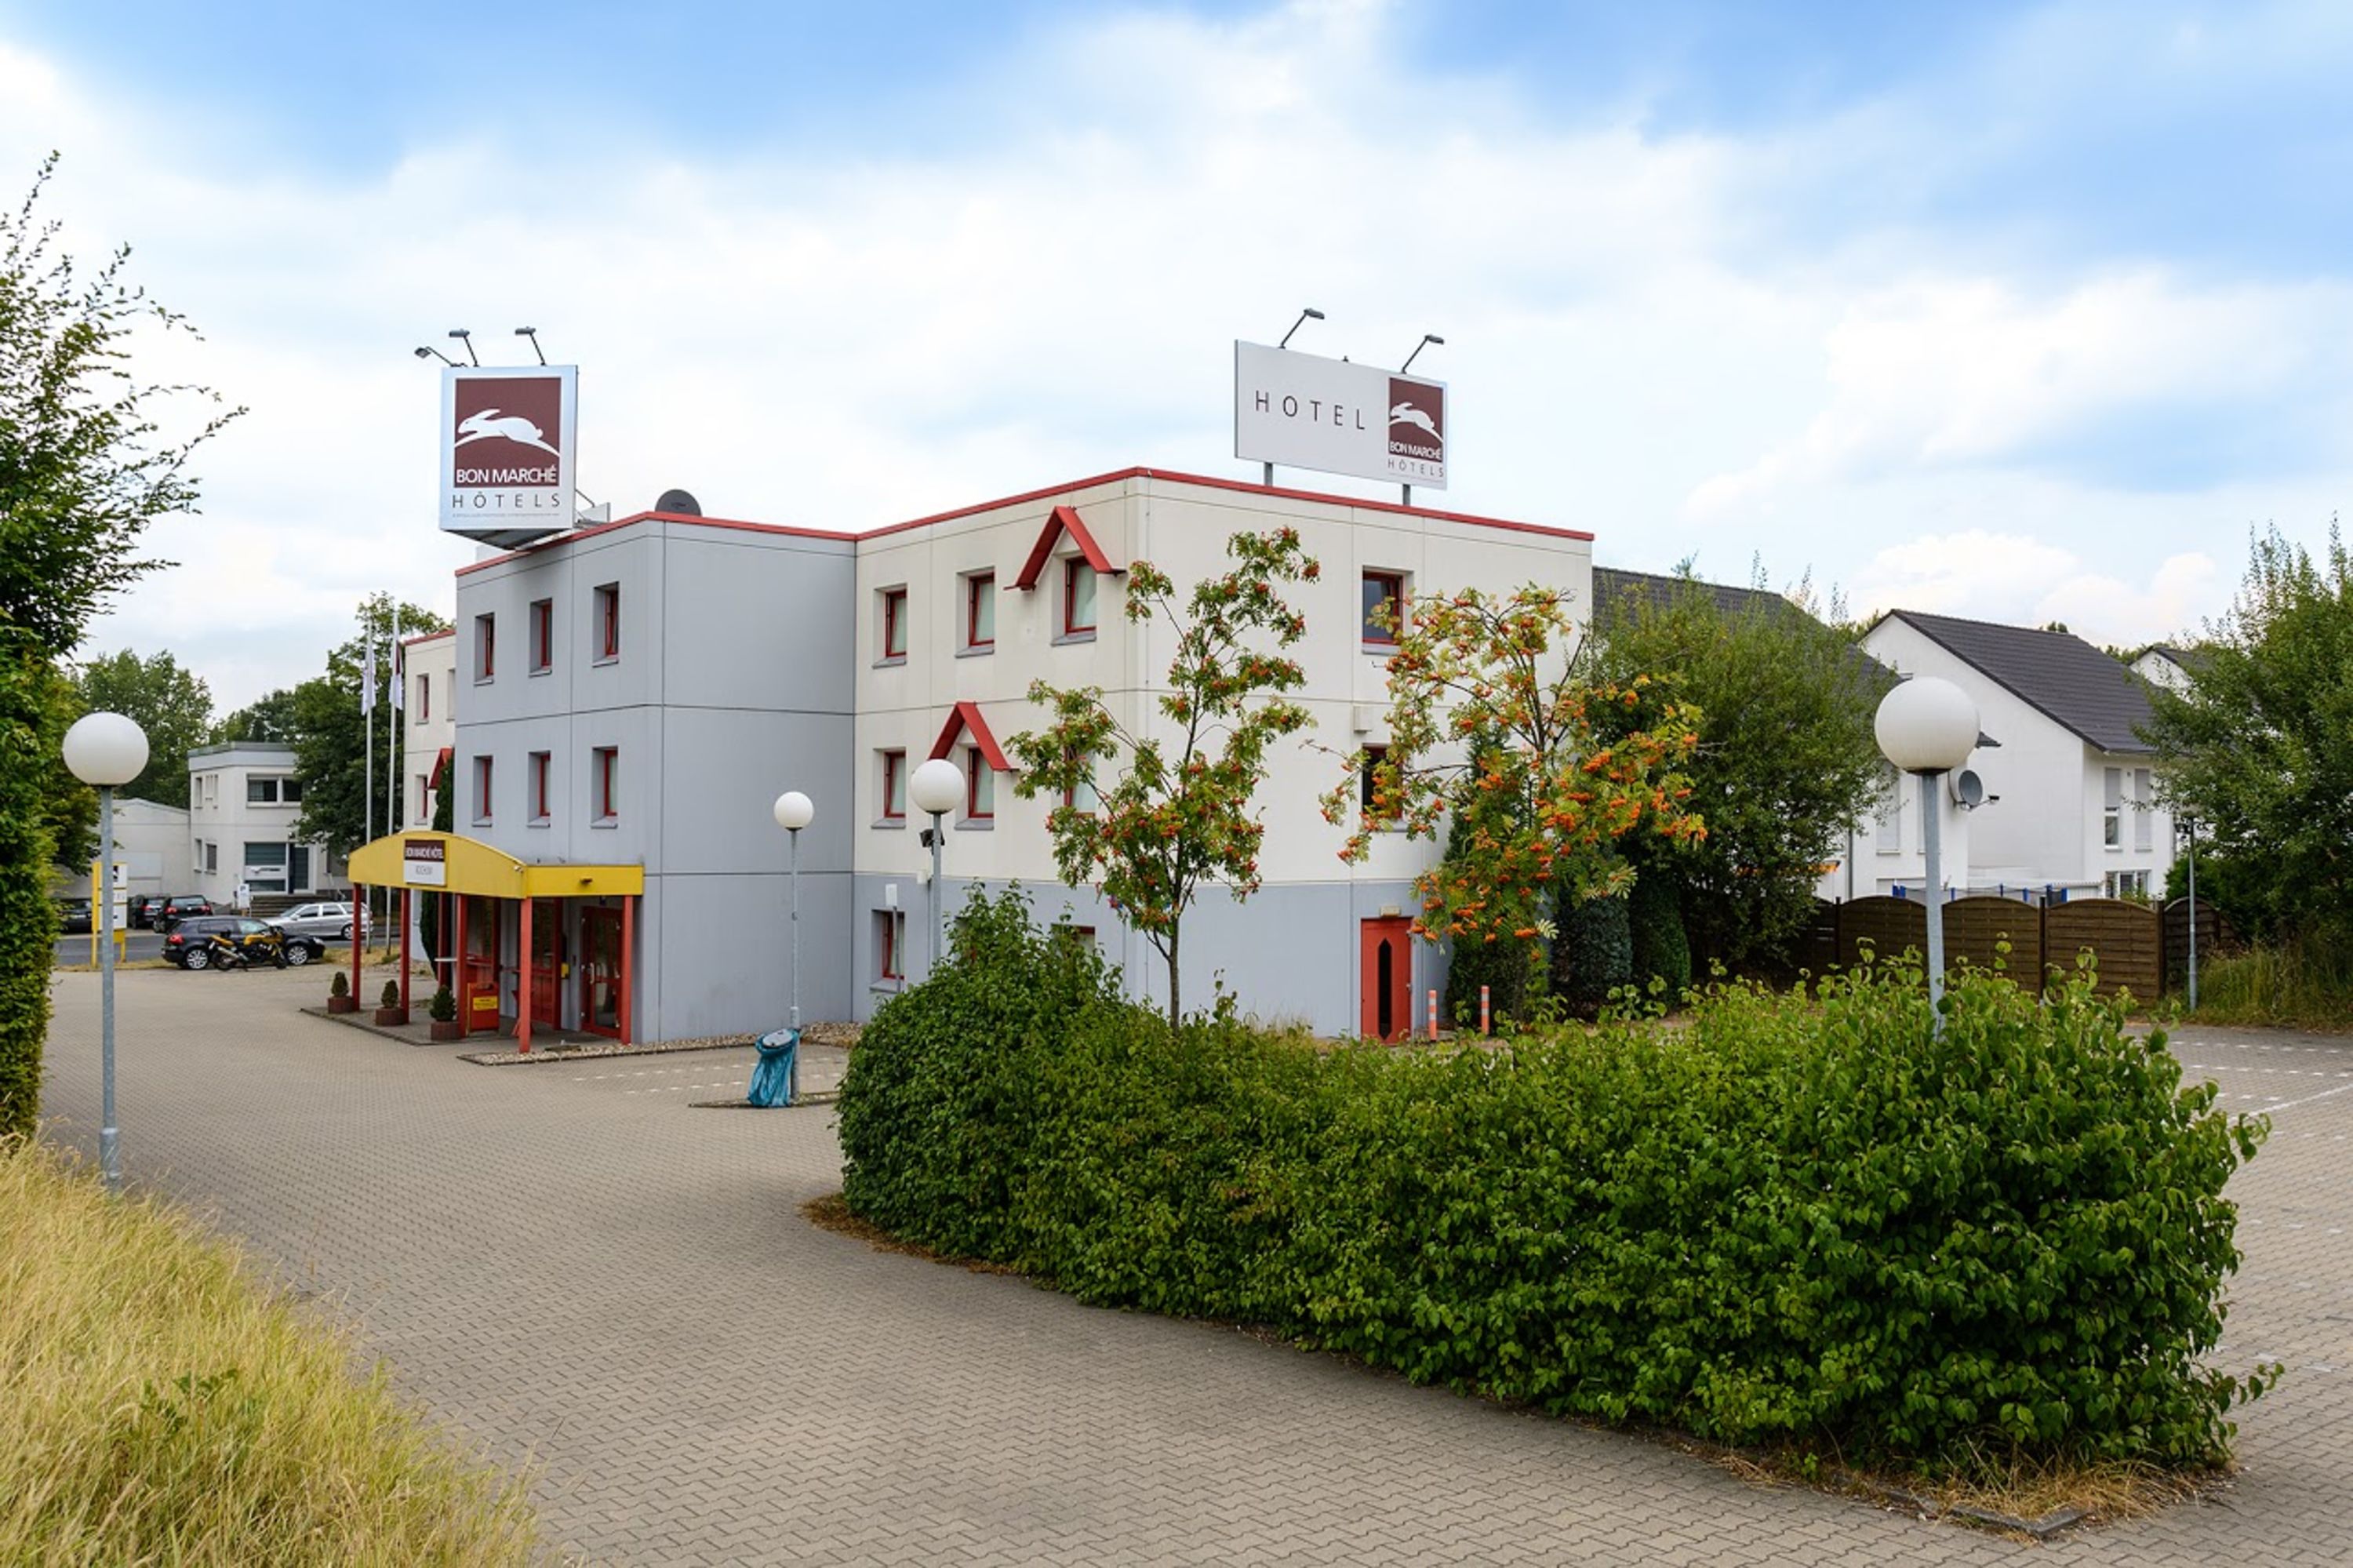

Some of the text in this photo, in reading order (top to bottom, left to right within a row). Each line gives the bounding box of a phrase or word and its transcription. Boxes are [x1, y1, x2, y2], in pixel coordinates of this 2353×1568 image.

[1255, 390, 1366, 430] HOTEL
[1389, 441, 1442, 460] BON MARCHÉ
[456, 464, 557, 483] BON MARCHÉ
[1387, 458, 1444, 477] HÔTELS
[452, 491, 561, 509] HÔTELS
